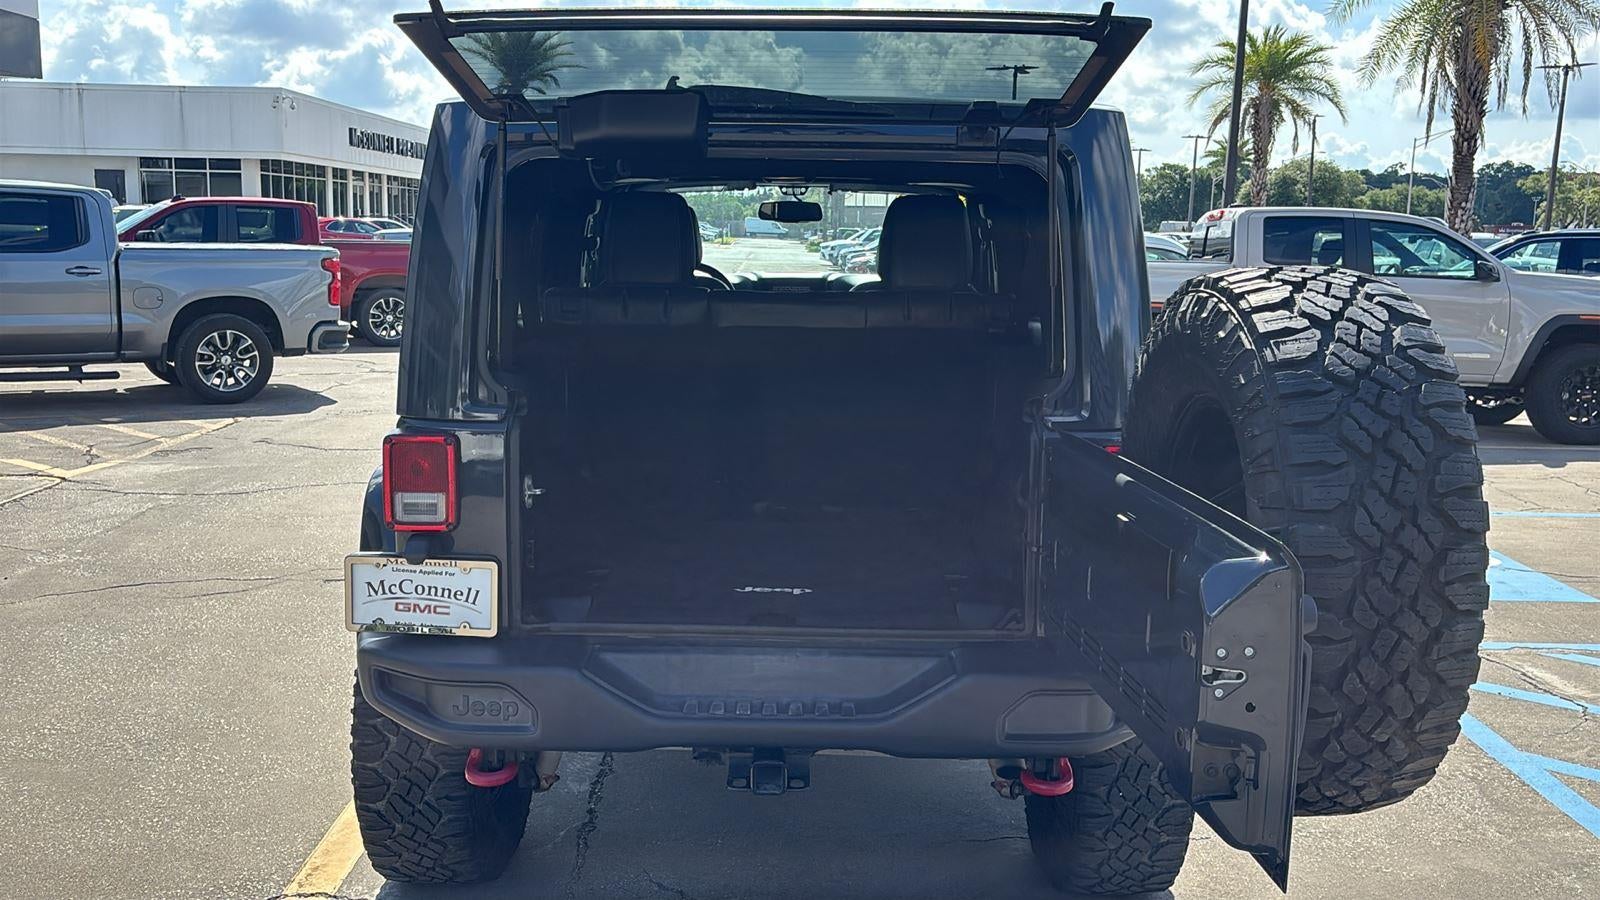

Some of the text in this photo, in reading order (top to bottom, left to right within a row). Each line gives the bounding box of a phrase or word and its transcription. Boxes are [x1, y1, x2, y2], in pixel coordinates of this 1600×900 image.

[386, 558, 458, 567] Mcnnell
[365, 578, 480, 606] McConnell
[734, 586, 813, 595] Jeep
[394, 602, 451, 615] GMC
[452, 694, 519, 721] Jeep
